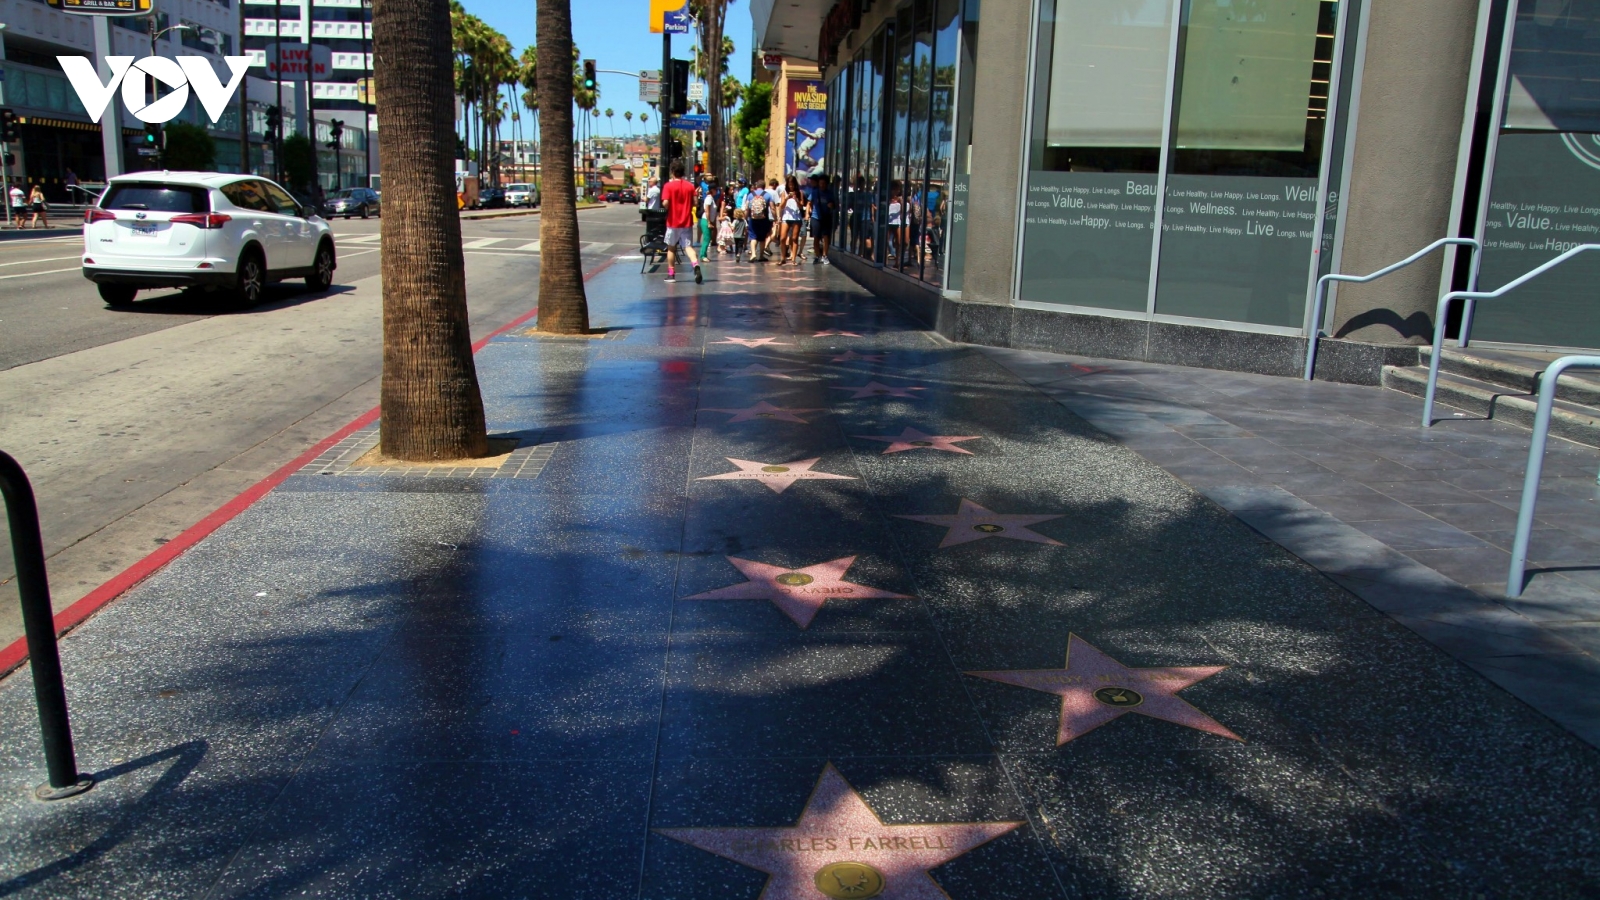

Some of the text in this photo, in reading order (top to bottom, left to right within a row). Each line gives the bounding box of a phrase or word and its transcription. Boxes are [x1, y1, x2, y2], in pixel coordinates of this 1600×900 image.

[665, 24, 687, 32] Parking
[282, 50, 311, 60] LIVE
[764, 54, 782, 62] CVS
[1186, 190, 1209, 198] Healthy.
[1225, 192, 1245, 200] Happy.
[1053, 194, 1086, 209] Value.
[1121, 203, 1132, 211] Live
[1133, 204, 1152, 212] Happy.
[1190, 202, 1237, 216] Wellness.
[1242, 209, 1255, 217] Live
[1256, 210, 1281, 218] Healthy.
[1491, 202, 1518, 212] Healthy.
[1521, 203, 1535, 211] Live
[1537, 204, 1561, 214] Happy.
[1564, 205, 1579, 213] Live
[1049, 218, 1068, 226] Healthy.
[1081, 215, 1111, 229] Happy.
[1172, 224, 1184, 232] Live
[1185, 225, 1208, 234] Healthy.
[1223, 227, 1243, 235] Happy.
[1247, 221, 1274, 236] Live
[1507, 212, 1554, 230] Value.
[1555, 223, 1570, 231] Live
[1500, 240, 1527, 250] Healthy.
[1529, 241, 1544, 249] Live
[731, 836, 950, 851] CHARLES FARRELL
